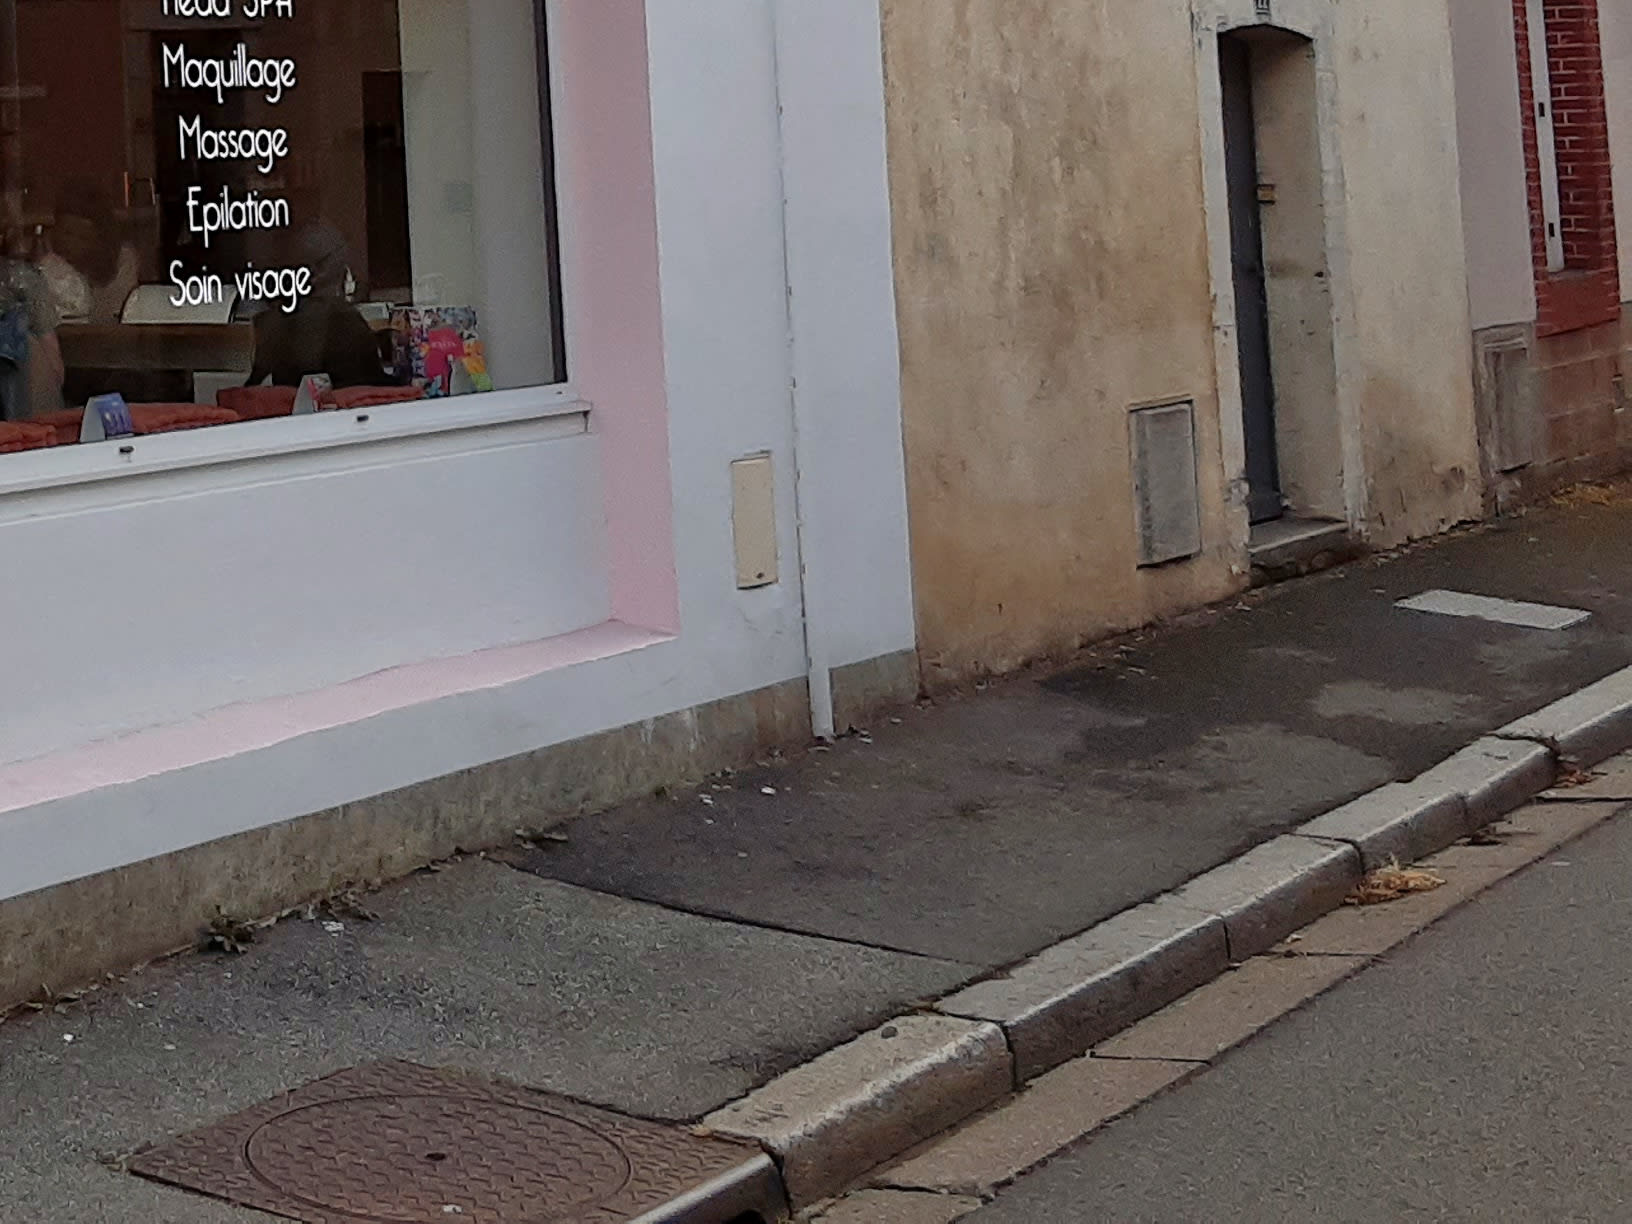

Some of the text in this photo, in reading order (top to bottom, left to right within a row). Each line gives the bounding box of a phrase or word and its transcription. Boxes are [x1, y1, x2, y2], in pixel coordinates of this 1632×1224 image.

[163, 43, 294, 103] Maquillage
[179, 116, 287, 172] Massage
[186, 186, 288, 247] Epilation
[169, 260, 310, 312] Soin visage
